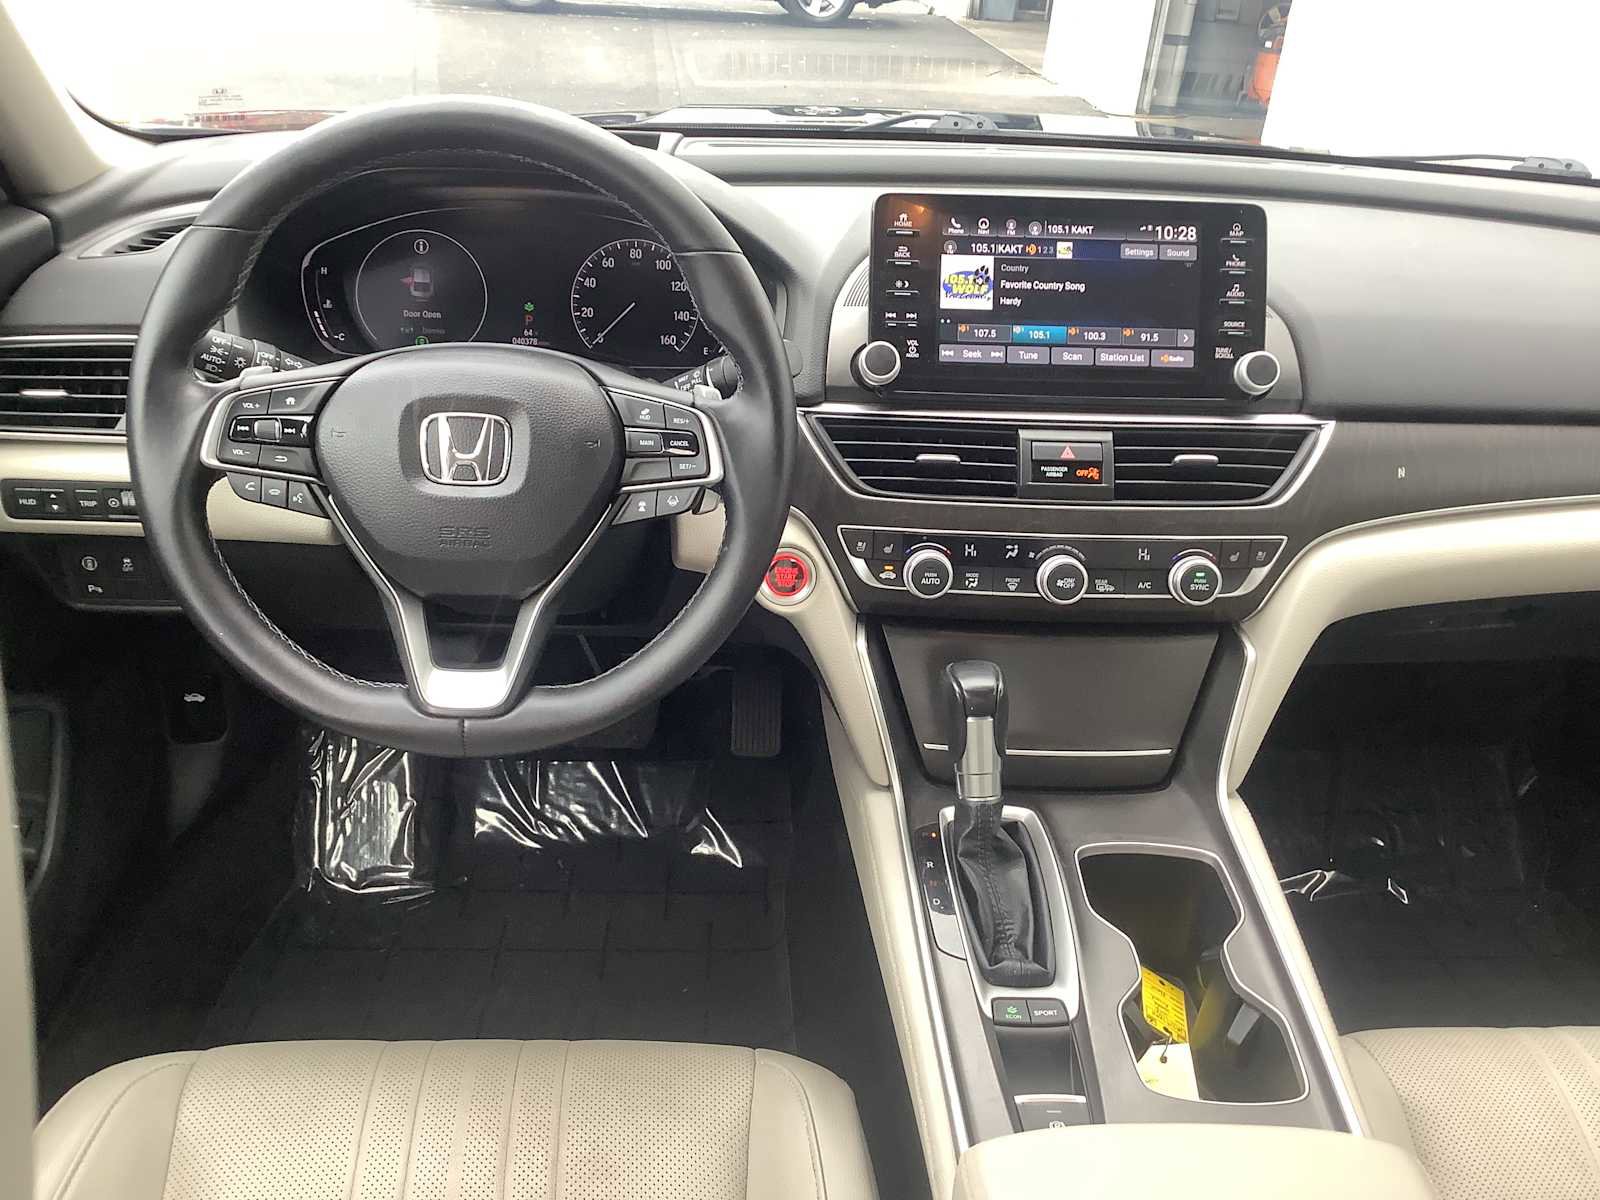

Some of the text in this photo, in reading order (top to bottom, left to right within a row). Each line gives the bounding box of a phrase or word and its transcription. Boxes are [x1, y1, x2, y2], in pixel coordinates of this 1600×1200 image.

[1048, 224, 1070, 234] 105.1
[1071, 225, 1094, 235] KAKT
[1156, 226, 1197, 241] 10:28
[630, 249, 642, 259] 80
[970, 244, 1024, 254] 105.1 KAKT
[1125, 248, 1154, 257] Settings
[602, 258, 615, 268] 60
[656, 260, 672, 271] 100
[321, 267, 328, 275] H
[1001, 264, 1029, 274] Country
[584, 278, 596, 288] 40
[671, 281, 687, 291] 120
[1001, 280, 1086, 292] Favorite Country Song
[1000, 297, 1022, 306] Hardy
[403, 310, 441, 320] Door Open
[581, 308, 594, 318] 20
[674, 311, 690, 321] 140
[525, 315, 533, 325] P
[974, 329, 997, 338] 107.5
[1028, 330, 1050, 339] 105.1
[1084, 332, 1106, 340] 100.3
[1141, 333, 1159, 342] 91.5
[512, 337, 538, 345] 040378
[660, 335, 677, 346] 160
[703, 347, 709, 355] E
[962, 349, 982, 358] Seek
[1019, 351, 1038, 359] Tune
[1062, 352, 1082, 360] Scan
[201, 353, 222, 364] AUTO
[1100, 353, 1145, 361] Station List
